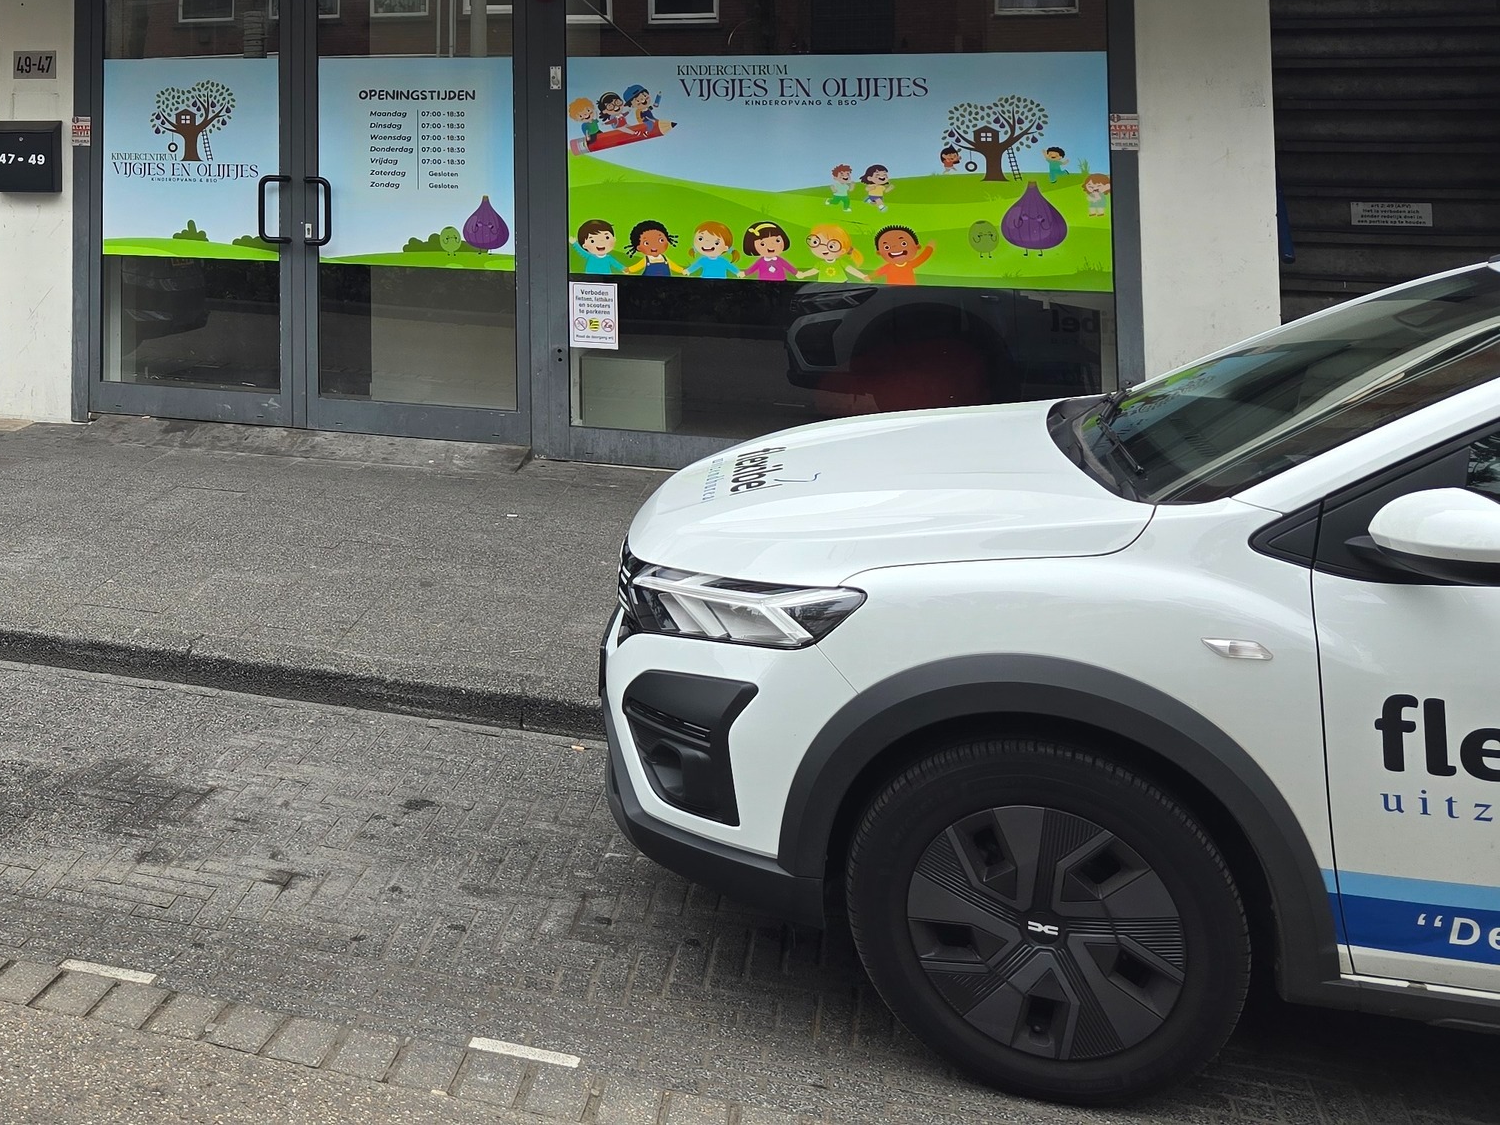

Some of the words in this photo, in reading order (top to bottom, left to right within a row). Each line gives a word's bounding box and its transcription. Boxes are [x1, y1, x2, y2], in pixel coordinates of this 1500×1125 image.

[16, 56, 53, 73] 49-47
[677, 65, 788, 75] KINDERCENTRUM
[679, 78, 768, 101] VIJGJES
[779, 78, 811, 97] EN
[822, 77, 928, 101] OLIJFJES
[358, 89, 476, 101] OPENINGSTIJDEN
[369, 122, 402, 130] Dinsdag
[369, 134, 412, 142] Woensdag
[369, 146, 414, 154] Donderdag
[111, 152, 177, 161] KINDERCENTRUM
[113, 162, 165, 178] VIJGJES
[172, 163, 190, 177] EN
[197, 163, 259, 181] OLIJFJES
[369, 181, 400, 189] Zondag
[1380, 789, 1493, 822] uitz
